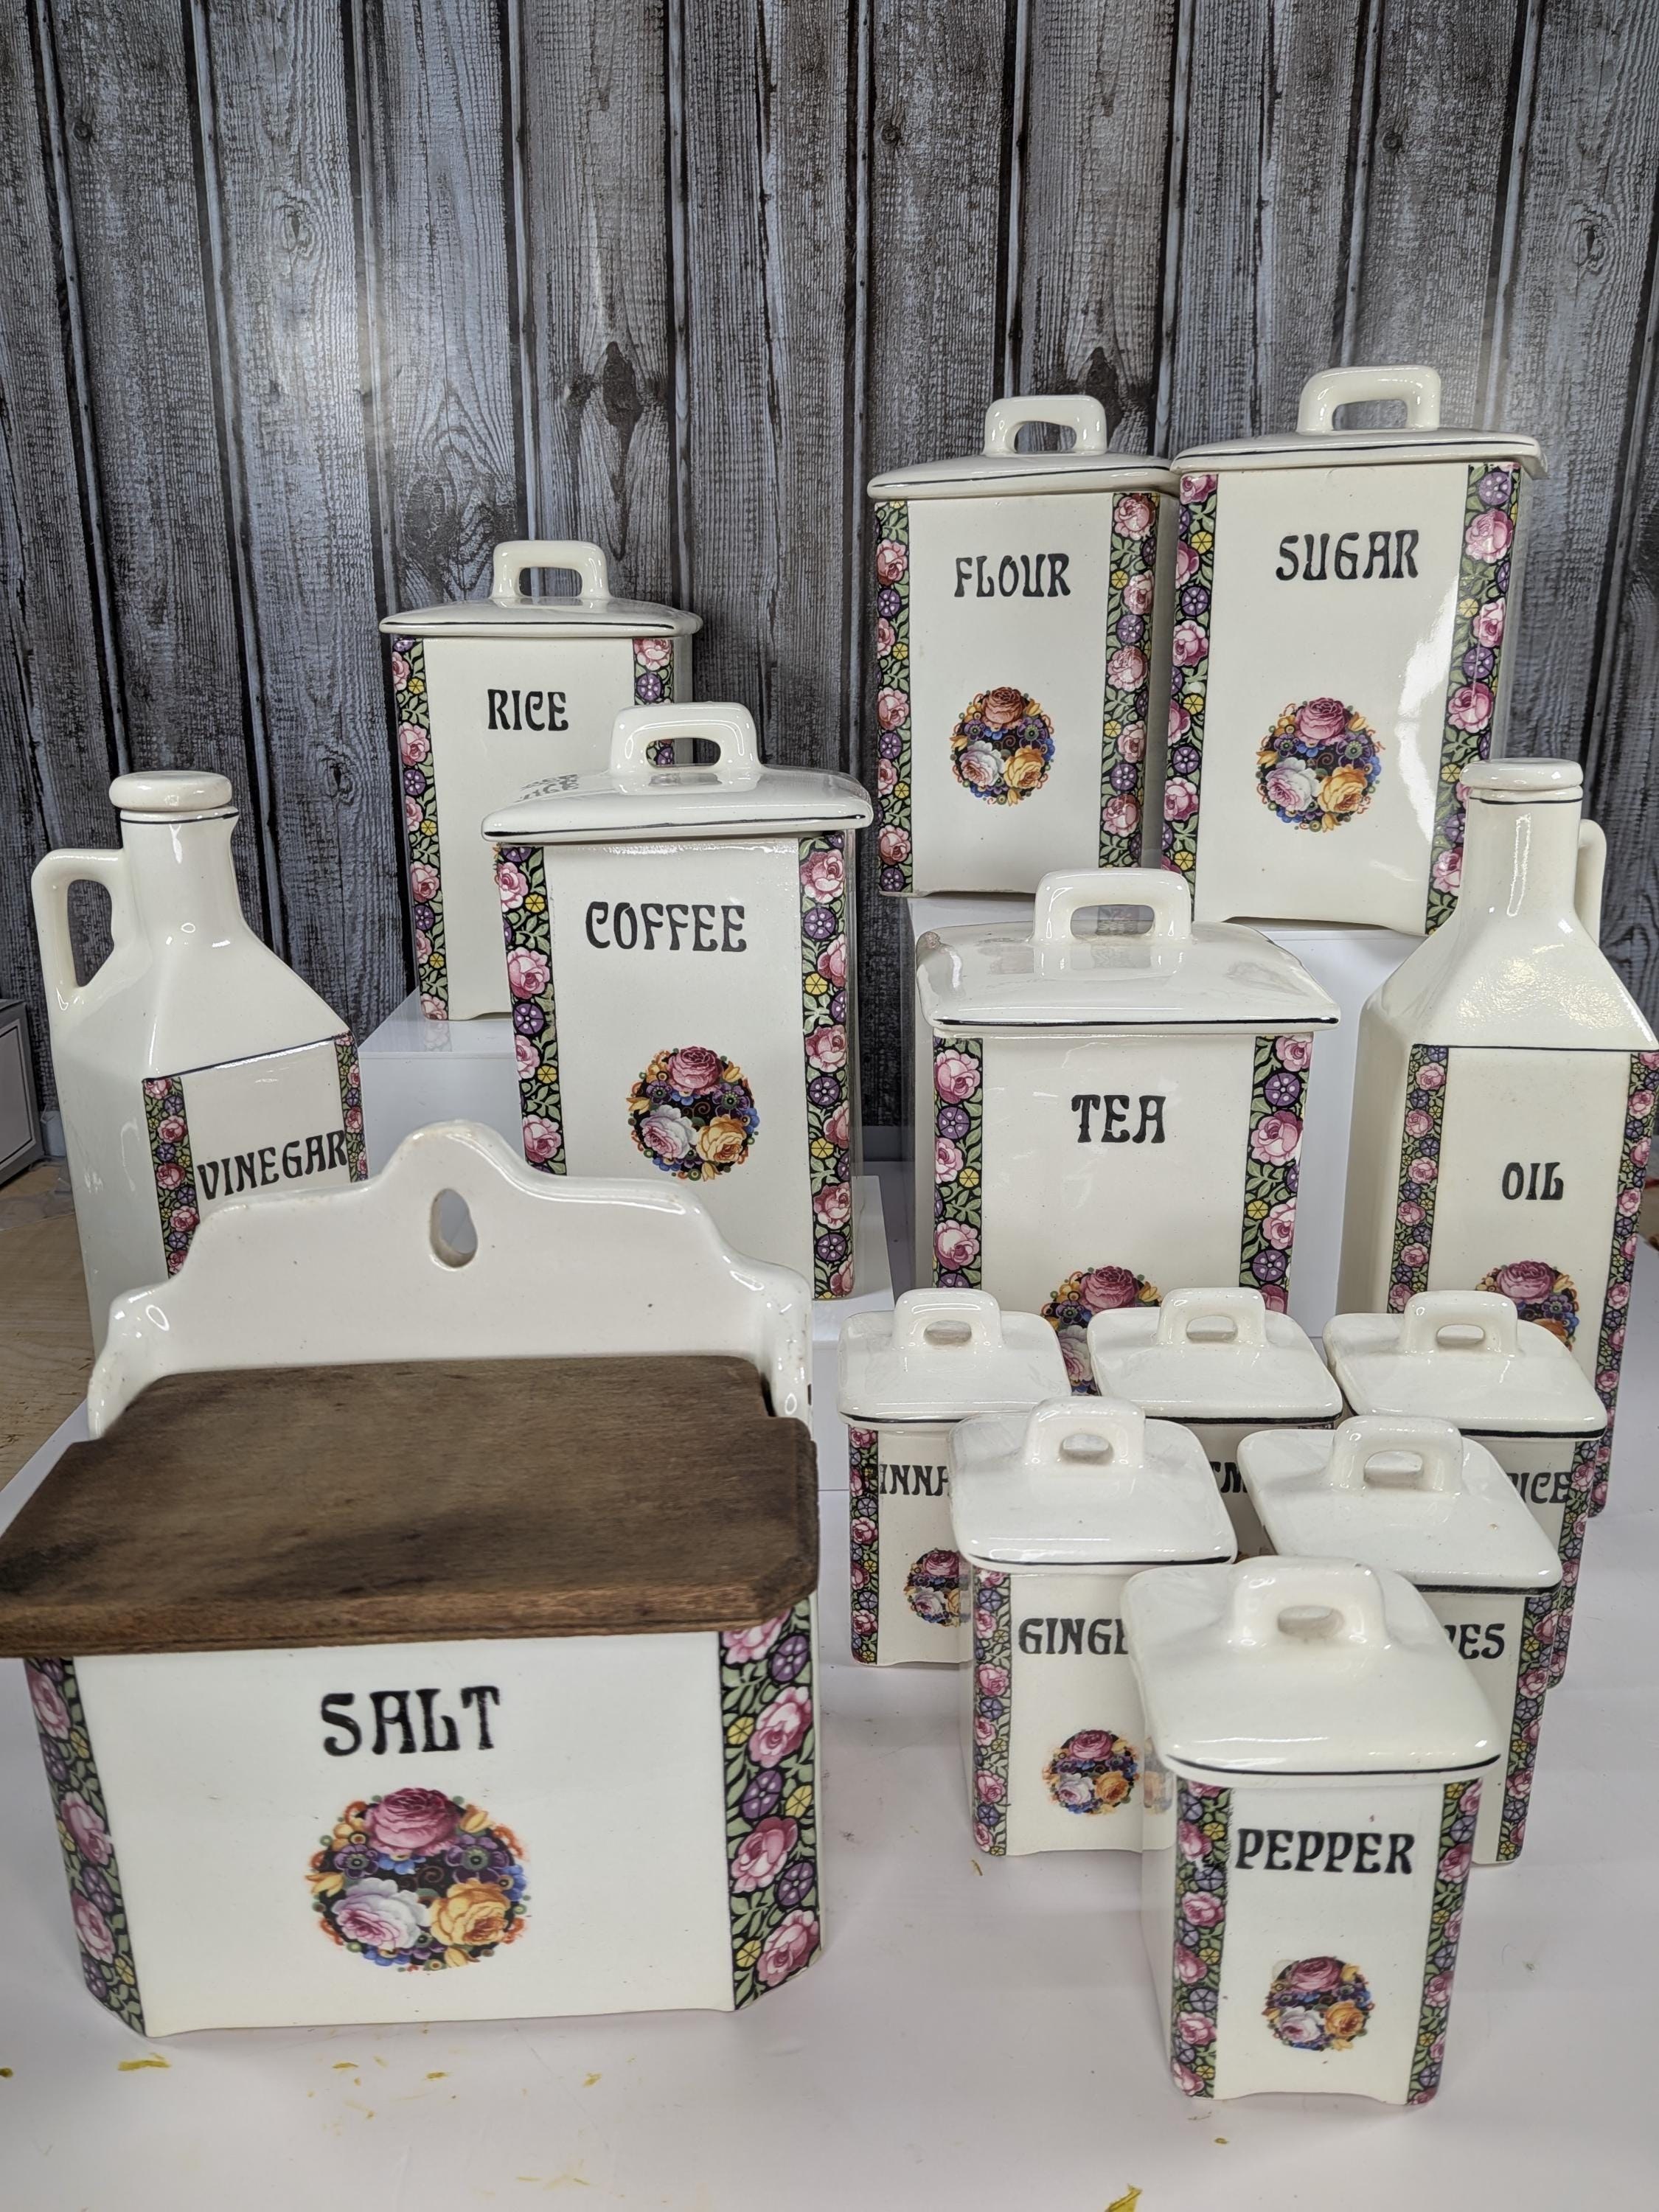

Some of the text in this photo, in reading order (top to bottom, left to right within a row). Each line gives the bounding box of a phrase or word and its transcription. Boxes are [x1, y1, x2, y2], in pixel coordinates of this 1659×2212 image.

[955, 554, 1071, 598] FLOUR
[1276, 530, 1419, 580] SUGAR
[488, 689, 568, 731] RICE
[585, 902, 746, 952] COFFEE
[1071, 1095, 1166, 1144] TEA
[197, 1130, 348, 1200] VINEGAR
[1503, 1162, 1563, 1200] OIL
[321, 1686, 500, 1756] SALT
[1235, 1829, 1415, 1874] PEPPER
